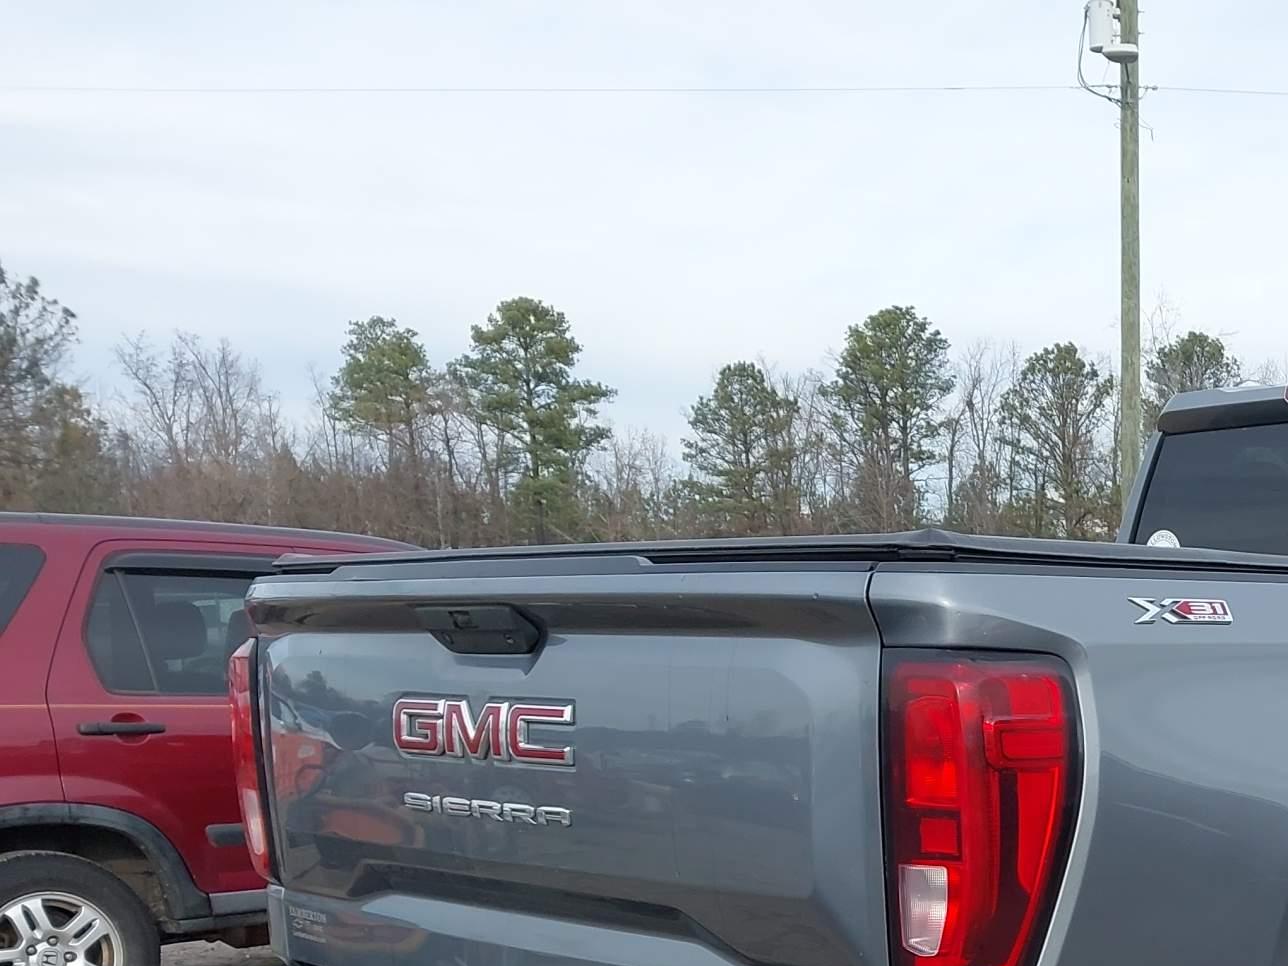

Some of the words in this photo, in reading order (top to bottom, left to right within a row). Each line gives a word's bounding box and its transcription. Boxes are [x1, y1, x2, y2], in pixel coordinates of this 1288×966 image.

[1127, 597, 1229, 624] X31
[393, 698, 575, 766] GMC
[403, 792, 573, 827] SIERRA
